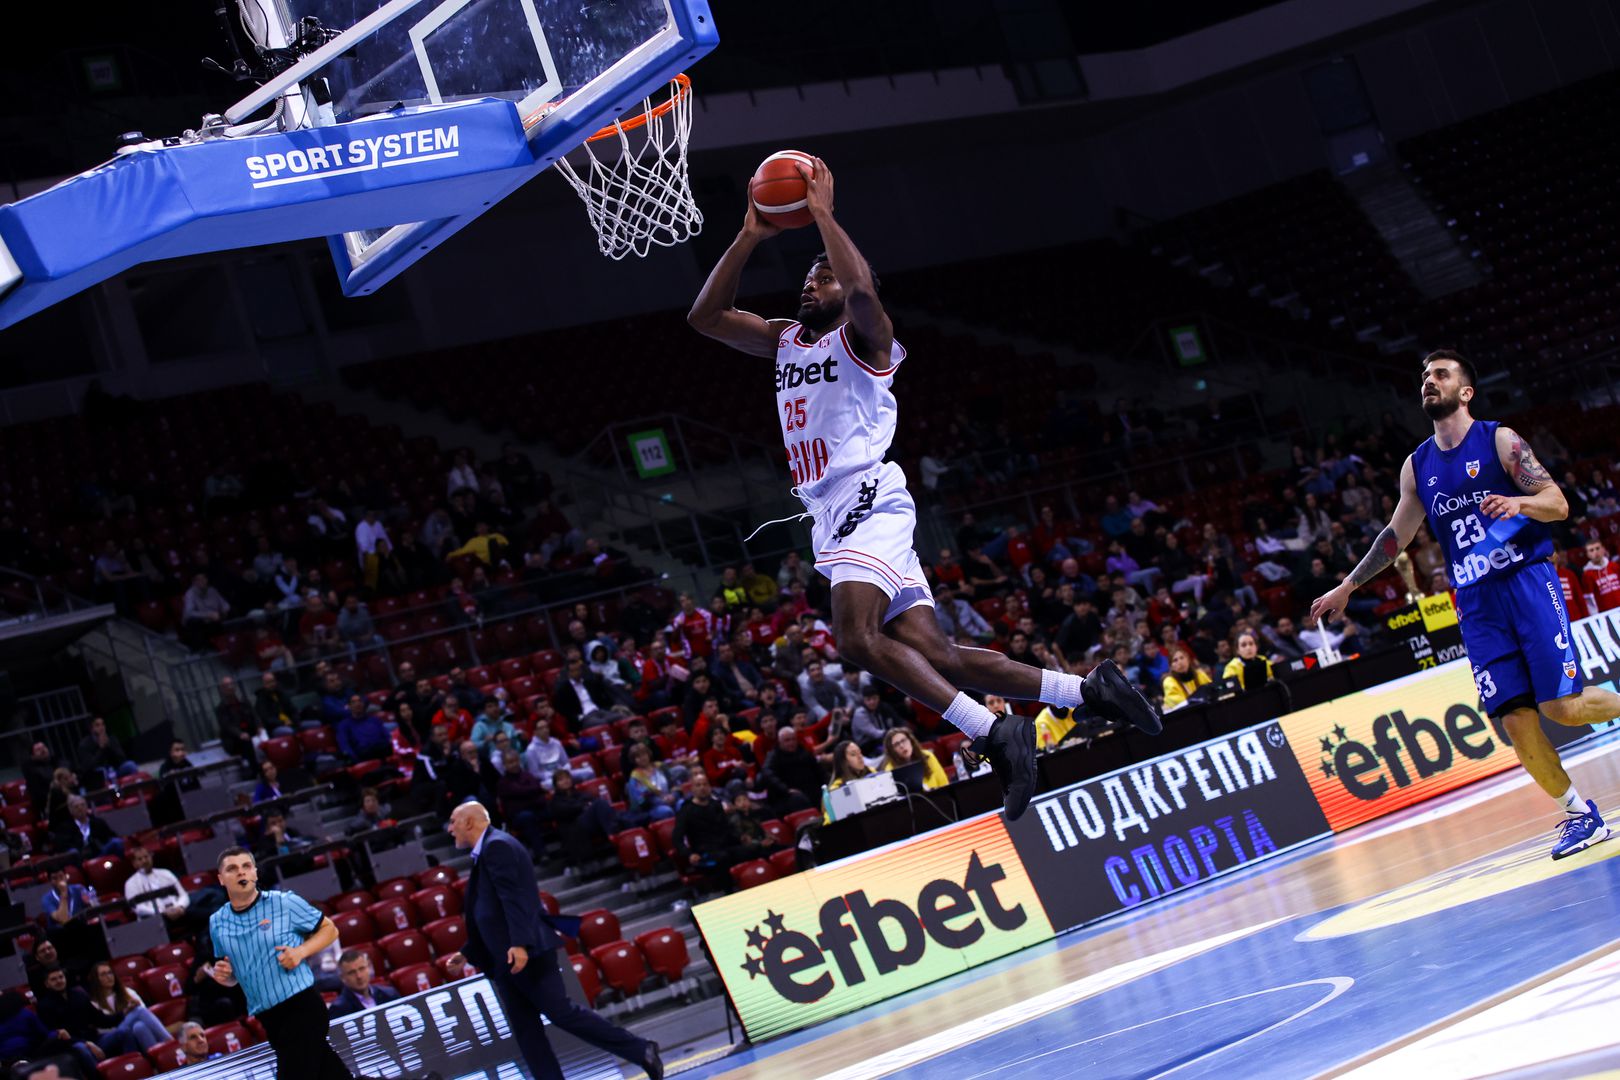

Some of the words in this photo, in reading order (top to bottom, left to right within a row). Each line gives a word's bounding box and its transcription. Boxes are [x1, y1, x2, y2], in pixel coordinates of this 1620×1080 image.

[246, 143, 343, 180] SPORT
[348, 125, 459, 168] SYSTEM
[784, 397, 807, 434] 25
[641, 445, 662, 462] 112
[1451, 513, 1486, 550] 23
[1453, 541, 1524, 585] efbet
[1035, 731, 1278, 852] ПОДКРЕПЯ
[1104, 809, 1278, 908] СПОРТА
[763, 850, 1028, 1004] efbet
[335, 978, 513, 1080] КРЕП
